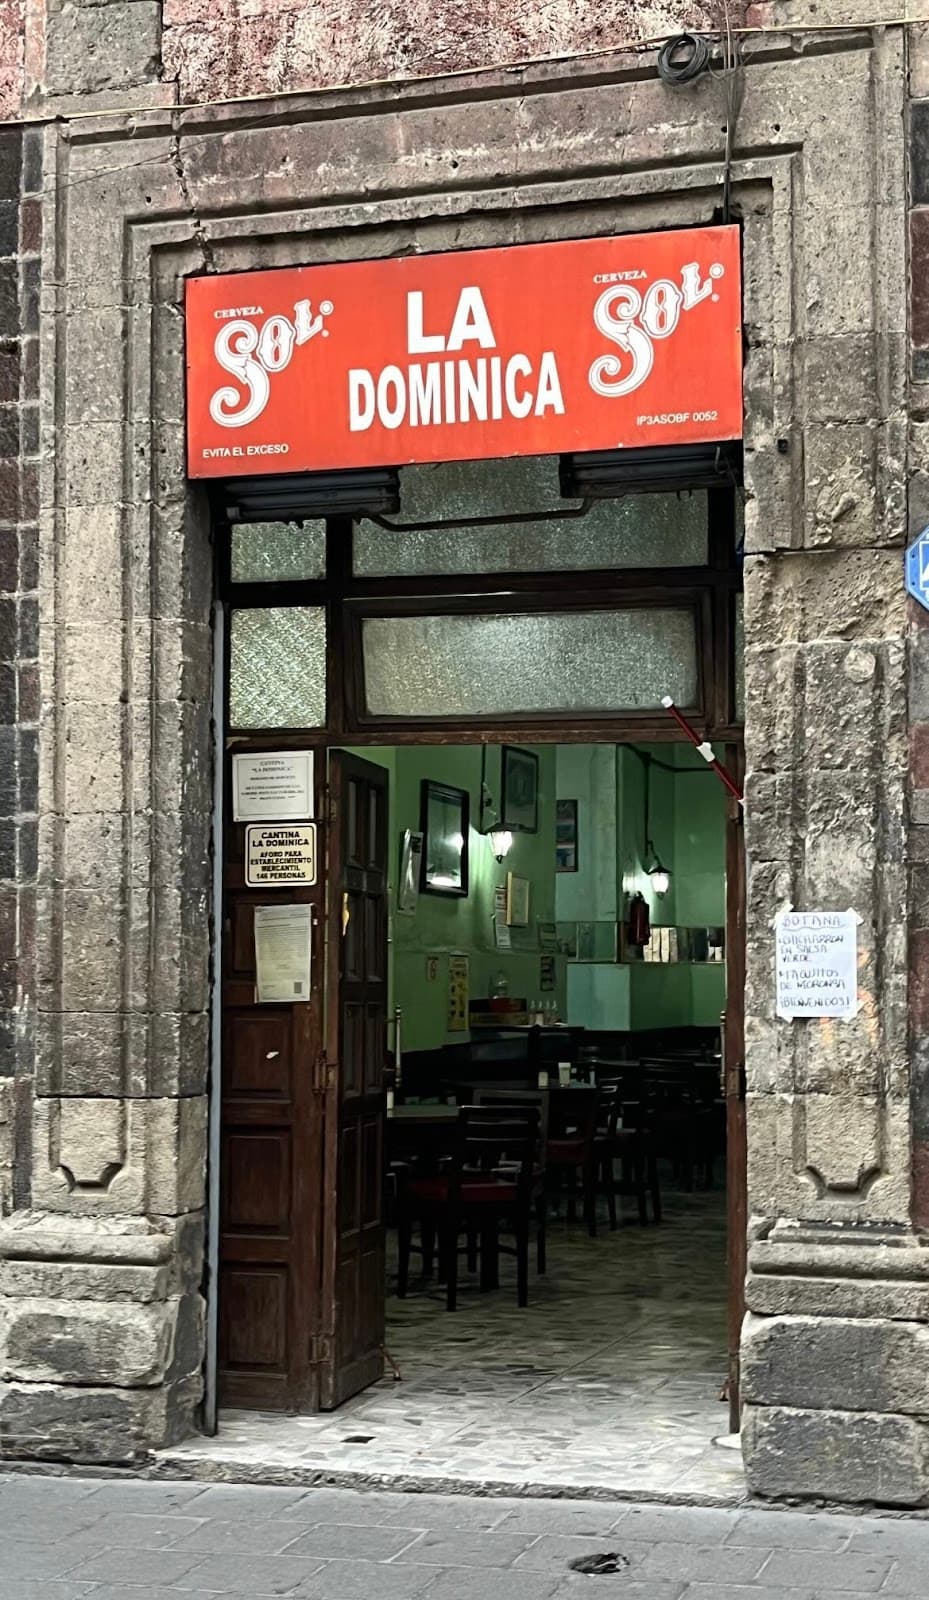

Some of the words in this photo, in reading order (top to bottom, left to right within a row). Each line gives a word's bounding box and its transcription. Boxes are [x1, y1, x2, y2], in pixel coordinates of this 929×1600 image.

[593, 269, 648, 284] CERVEZA
[214, 305, 265, 319] CERVEZA
[407, 286, 496, 354] LA
[348, 351, 565, 432] DOMINICA
[692, 410, 719, 422] 0052
[202, 446, 230, 459] EVITA
[233, 445, 245, 457] EL
[247, 443, 289, 456] EXCESO
[261, 831, 300, 839] CANTINA
[252, 840, 264, 848] LA
[266, 838, 309, 847] DOMINICA
[250, 857, 312, 865] ESTABLECIMIENTO
[270, 871, 306, 879] PERSONAS
[783, 914, 841, 927] BOTANA
